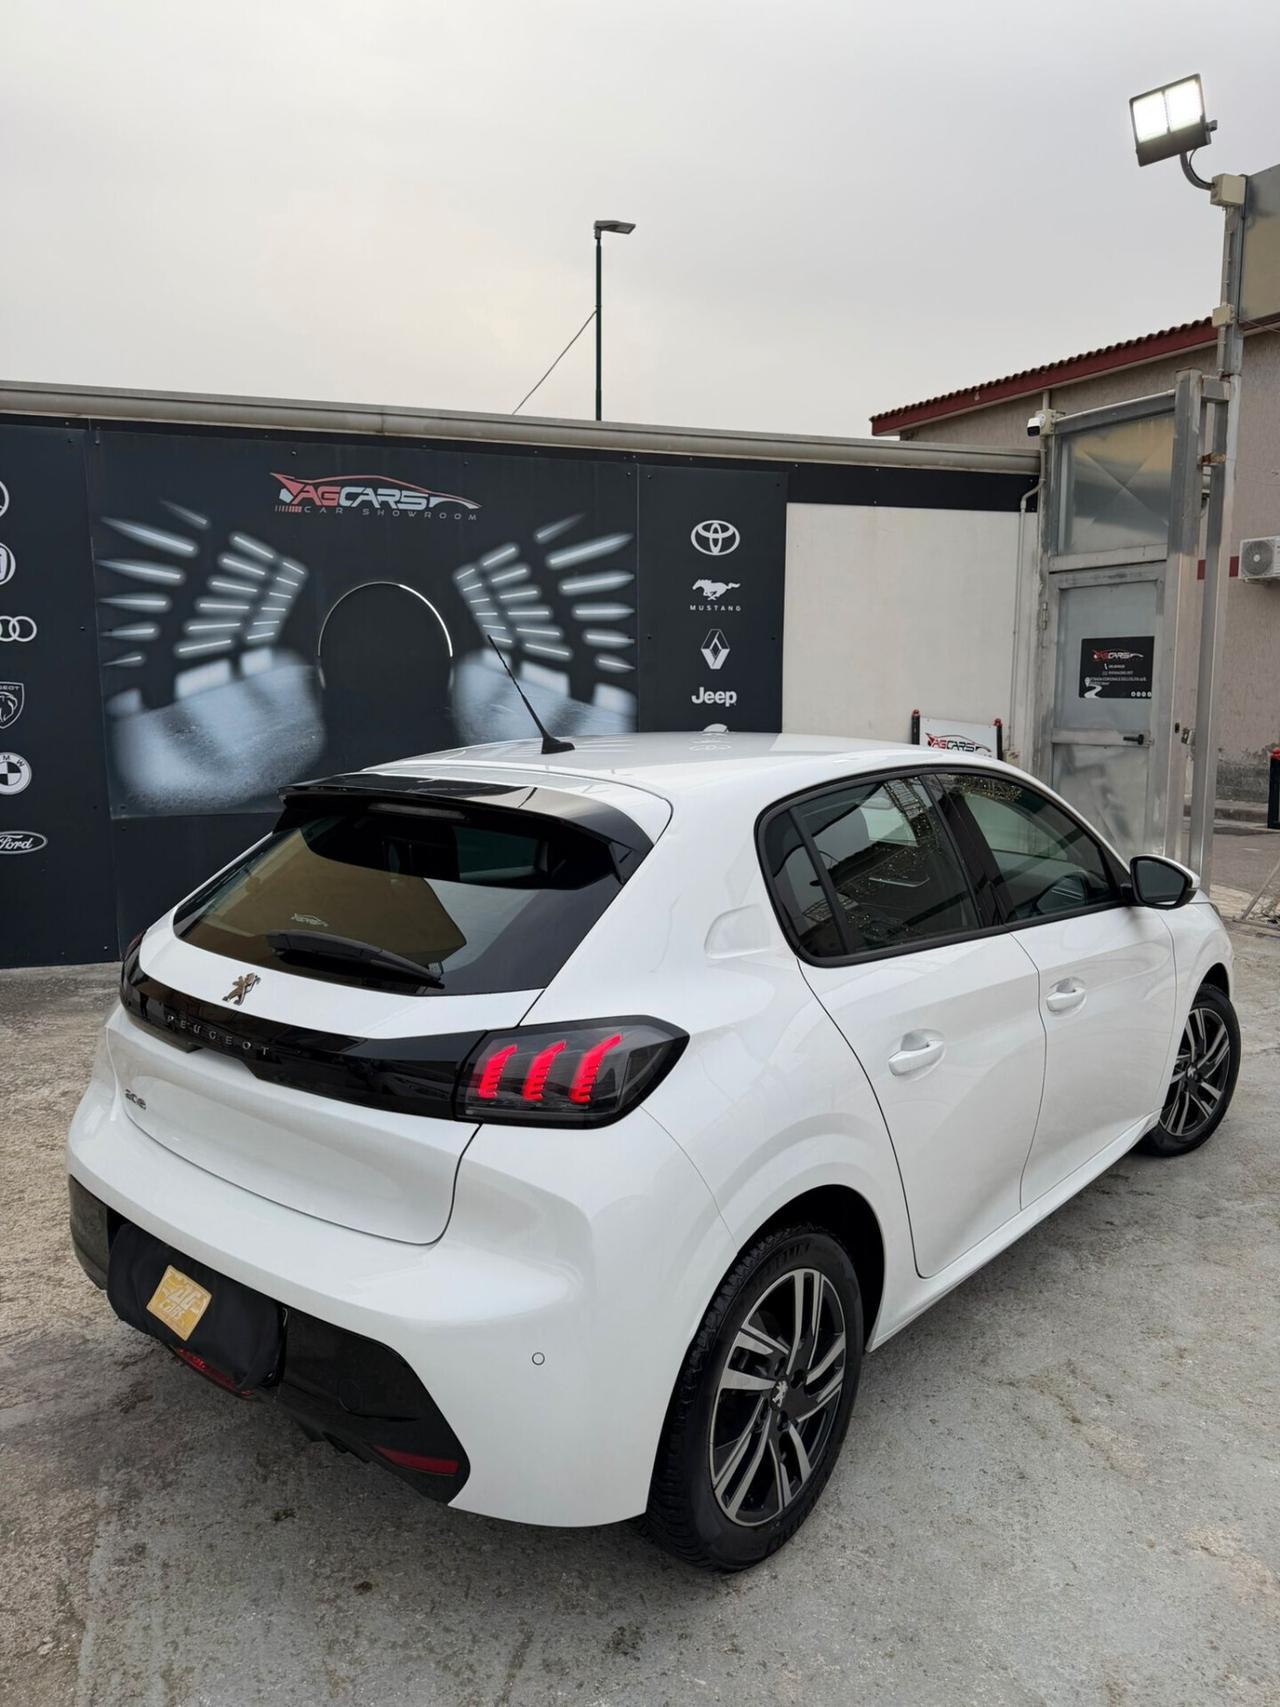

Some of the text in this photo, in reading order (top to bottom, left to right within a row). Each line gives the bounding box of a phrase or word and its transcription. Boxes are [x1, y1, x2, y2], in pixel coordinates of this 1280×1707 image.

[304, 506, 477, 521] CAR SHOWROOM
[690, 604, 742, 612] MUSTANG
[691, 687, 737, 707] Jeep
[167, 1014, 270, 1056] PEUGEOT
